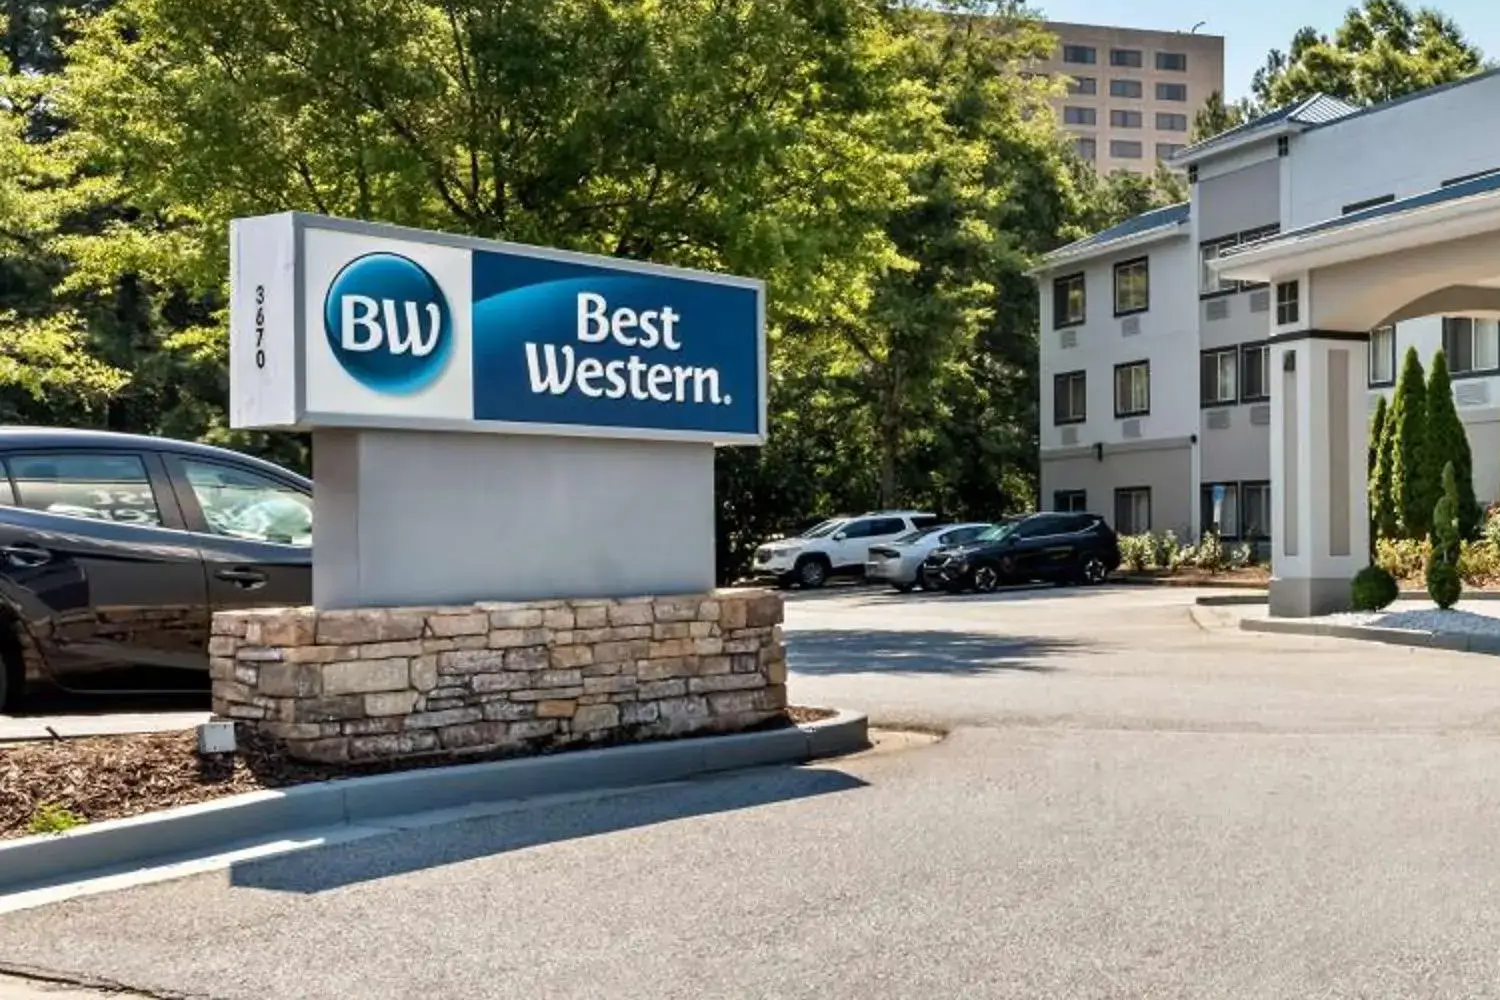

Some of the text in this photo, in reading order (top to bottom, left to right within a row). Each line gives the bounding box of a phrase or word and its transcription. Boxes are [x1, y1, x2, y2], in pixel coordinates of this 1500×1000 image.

[255, 284, 266, 369] 3670
[341, 294, 441, 357] BW
[576, 292, 682, 351] Best
